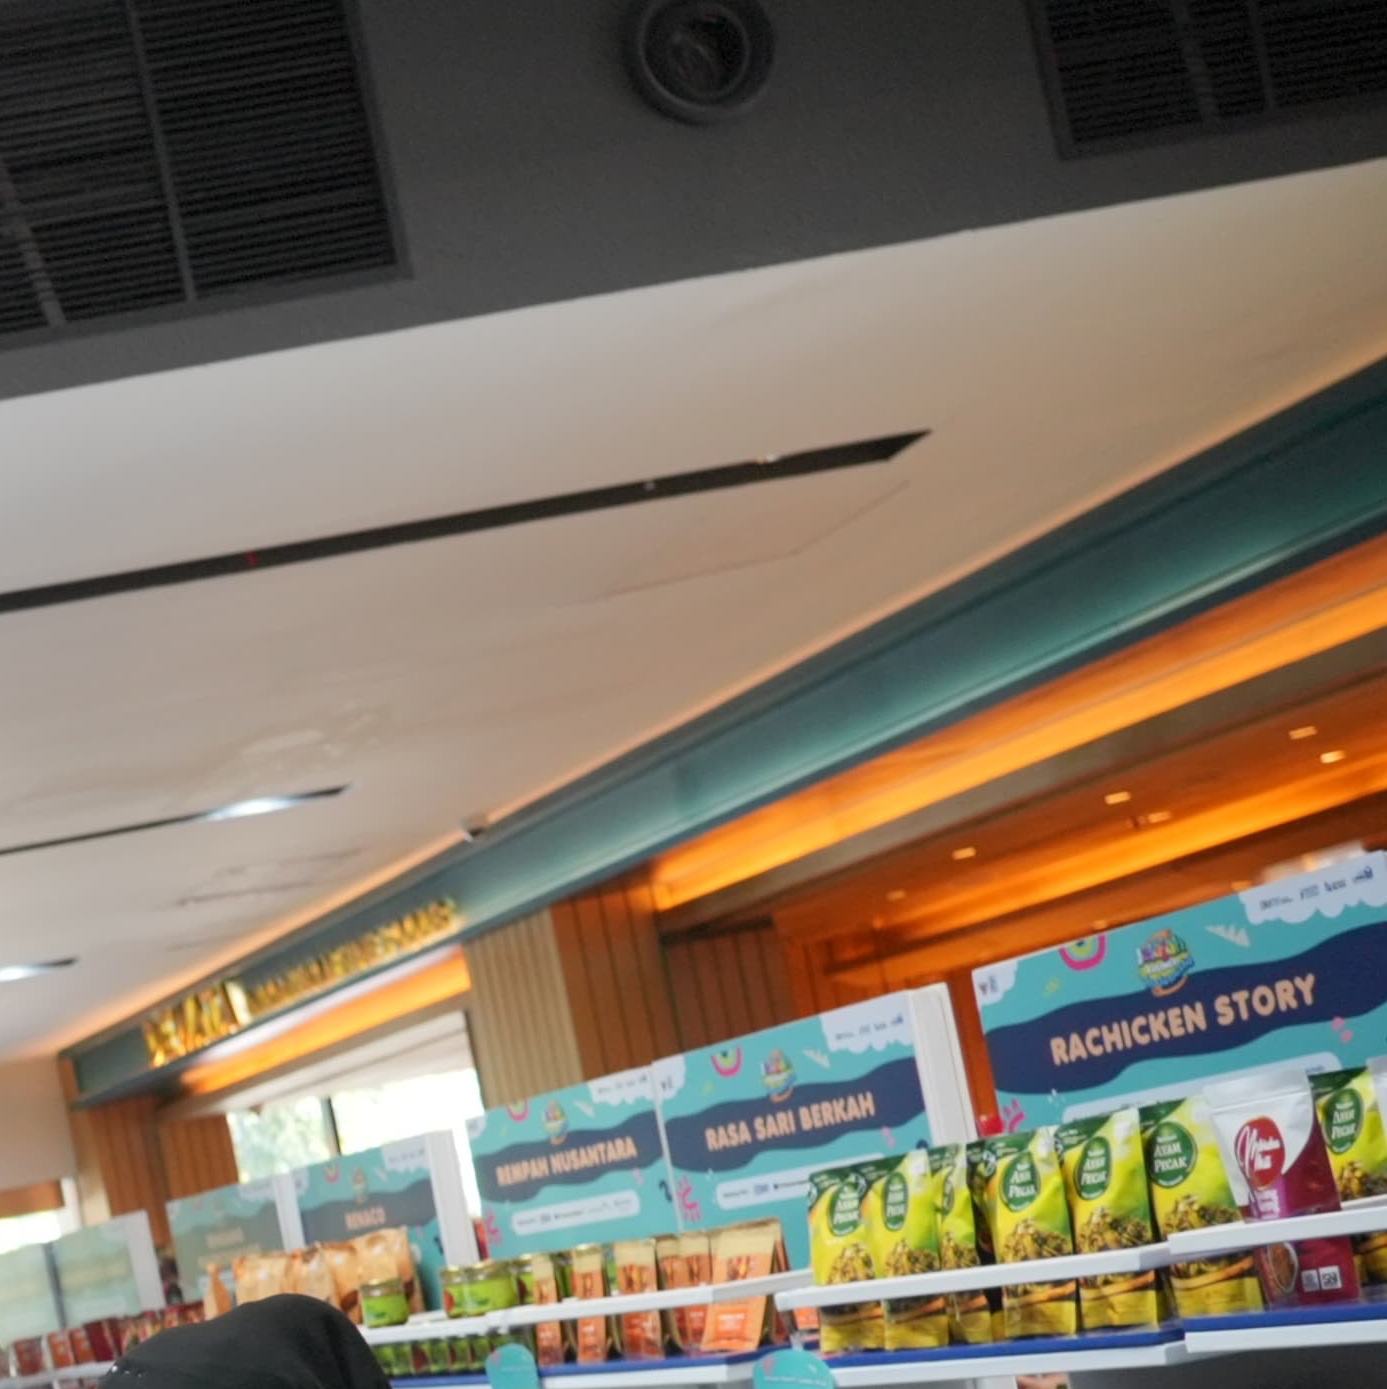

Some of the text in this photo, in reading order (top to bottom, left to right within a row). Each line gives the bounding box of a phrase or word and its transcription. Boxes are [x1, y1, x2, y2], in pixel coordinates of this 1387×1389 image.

[1050, 973, 1315, 1066] RACHICKEN STORY
[705, 1092, 875, 1151] RASA SARI BERKAH
[550, 1136, 637, 1174] NUSANTARA
[1154, 1141, 1182, 1157] AYAM
[1154, 1156, 1187, 1173] PECAK
